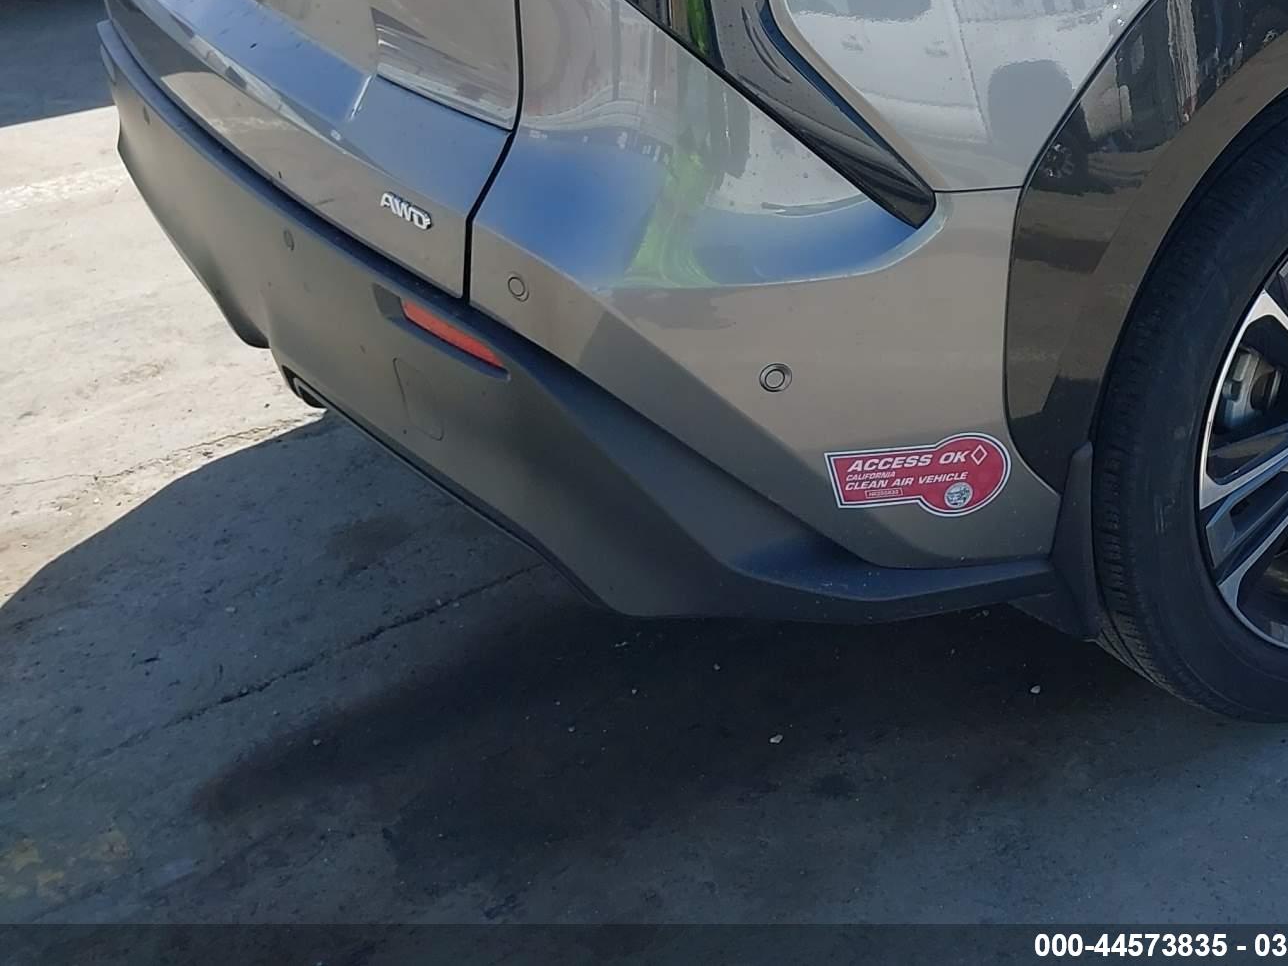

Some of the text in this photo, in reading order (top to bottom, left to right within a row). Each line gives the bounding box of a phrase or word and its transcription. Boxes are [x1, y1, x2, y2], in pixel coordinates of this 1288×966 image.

[380, 192, 431, 230] AWD
[847, 450, 971, 472] ACCESS OK
[845, 471, 969, 491] CLEAN AIR VEHICLE
[846, 471, 896, 481] CALIFORNIA
